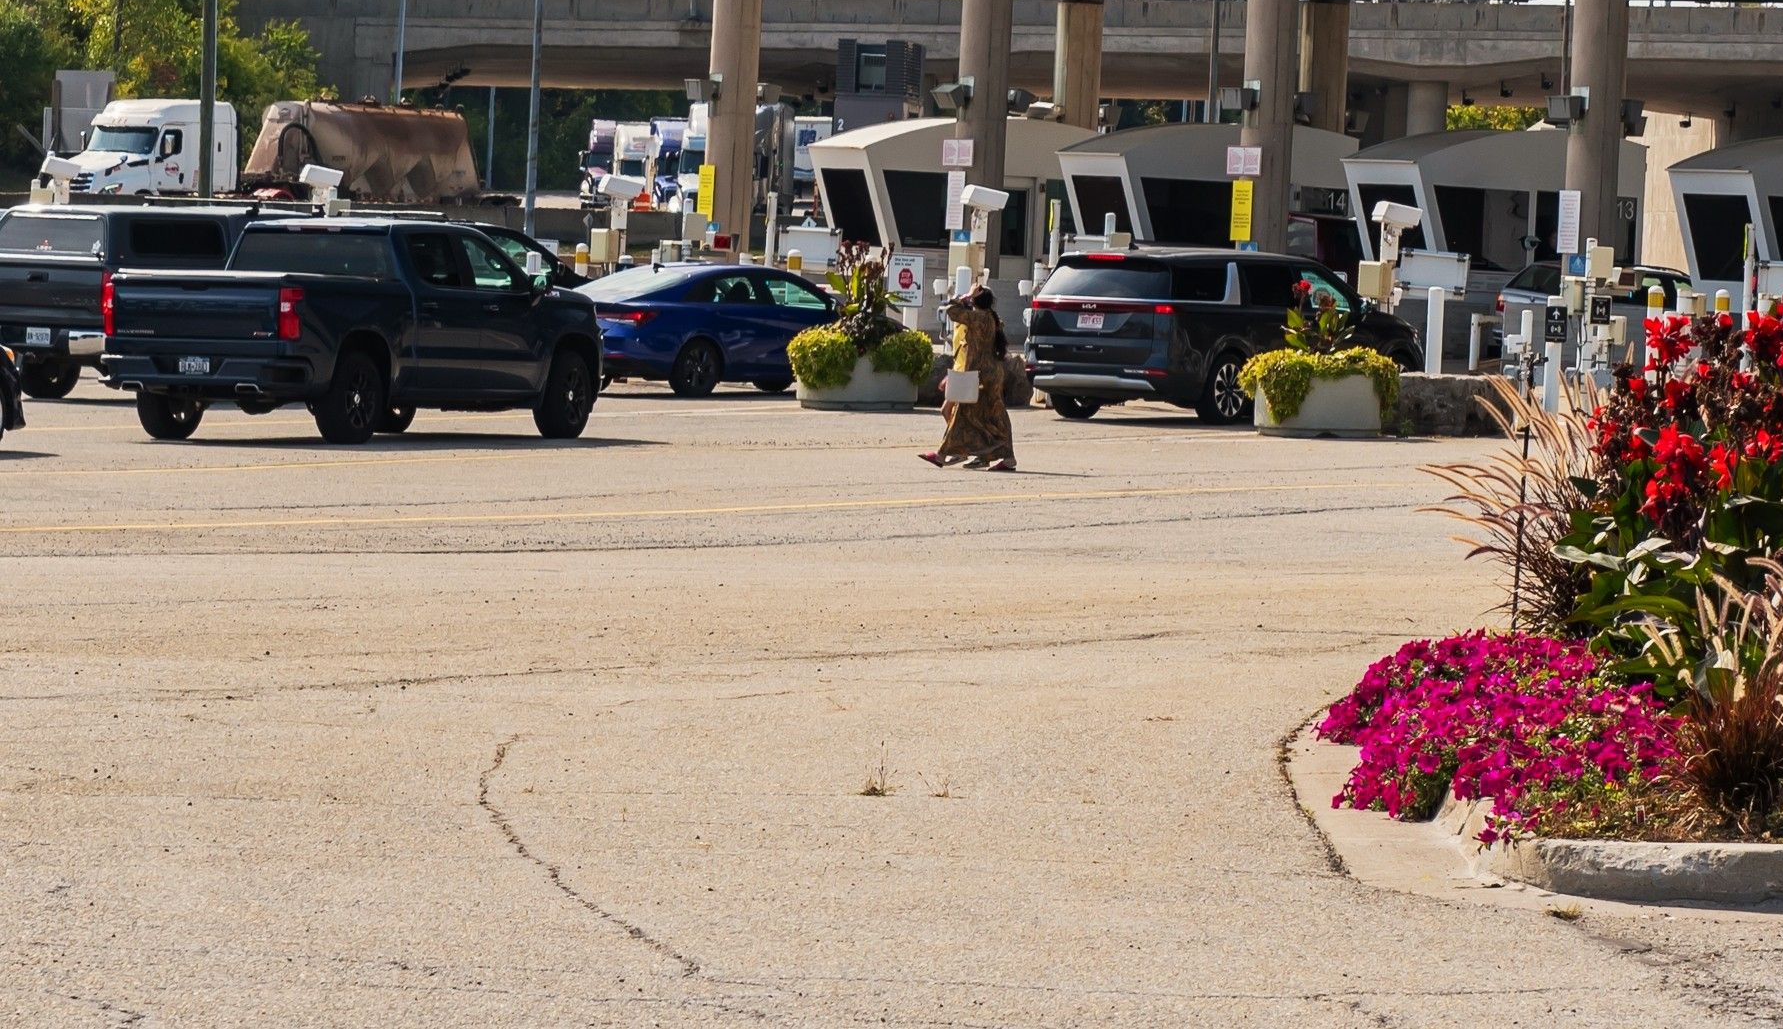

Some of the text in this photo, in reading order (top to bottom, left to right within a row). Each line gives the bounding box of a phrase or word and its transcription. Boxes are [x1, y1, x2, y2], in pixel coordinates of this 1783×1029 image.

[837, 118, 844, 131] 2
[1328, 191, 1346, 211] 14
[1617, 200, 1635, 220] 13
